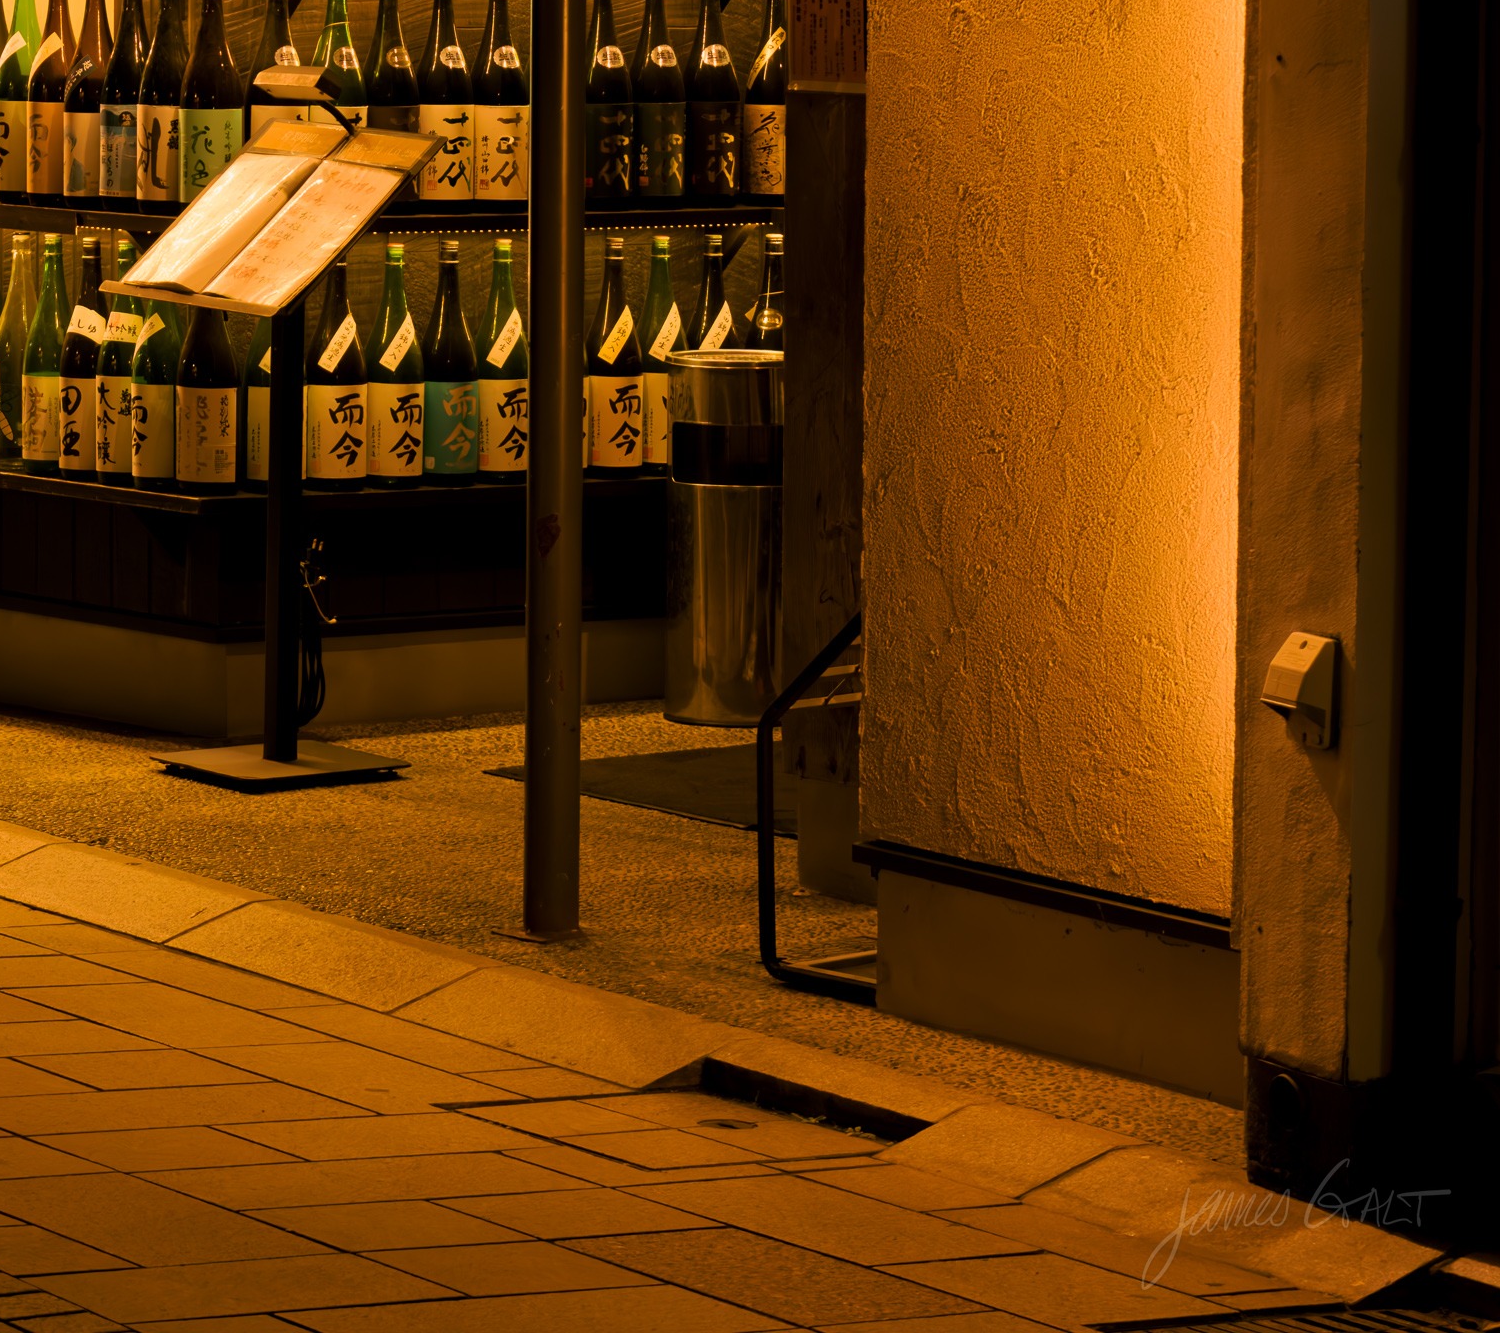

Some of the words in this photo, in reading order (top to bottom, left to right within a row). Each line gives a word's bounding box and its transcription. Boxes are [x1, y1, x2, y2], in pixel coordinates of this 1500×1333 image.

[438, 112, 472, 193] 十四代
[131, 395, 149, 457] 而今
[328, 392, 364, 467] 而今
[389, 392, 423, 467] 而今
[441, 384, 477, 460] 而今
[497, 387, 528, 461] 而今
[608, 383, 641, 456] 而今
